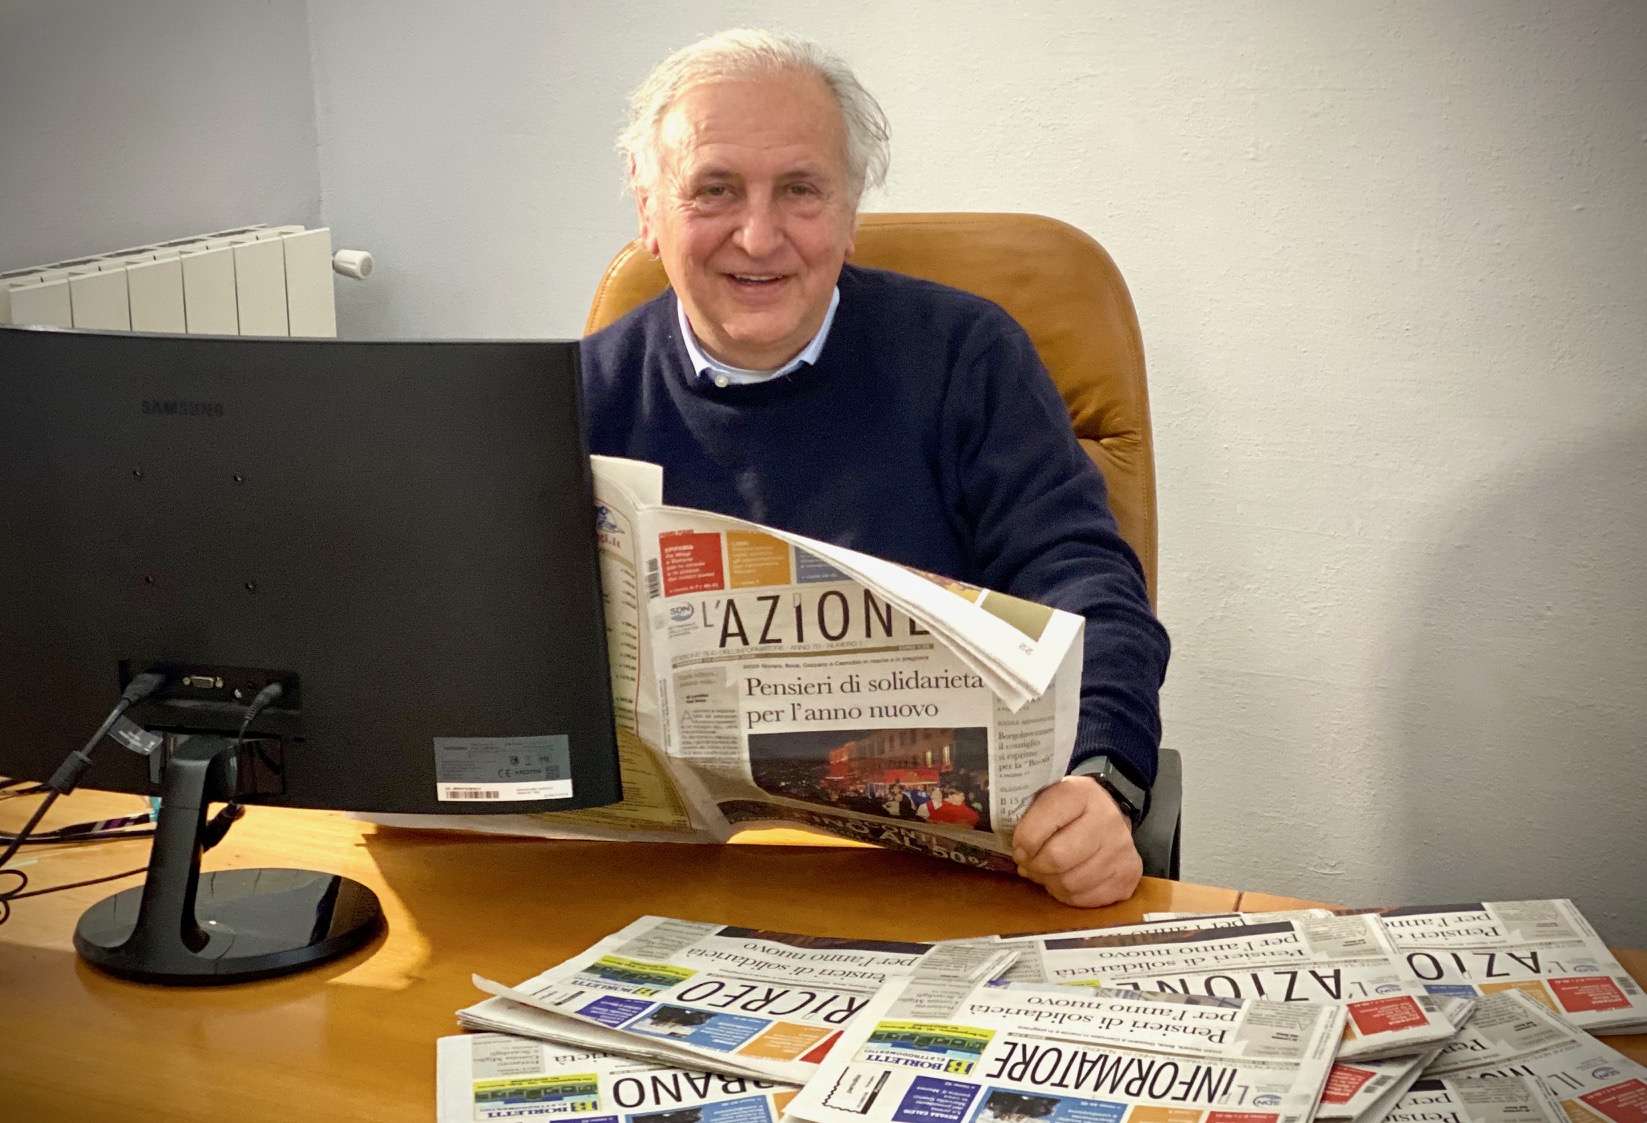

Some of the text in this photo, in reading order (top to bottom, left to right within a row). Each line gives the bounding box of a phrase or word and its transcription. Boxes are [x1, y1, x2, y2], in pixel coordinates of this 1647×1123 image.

[141, 400, 224, 417] SAMSUNG
[670, 606, 690, 615] SDN
[744, 676, 832, 697] Pensieri
[840, 674, 861, 694] di
[747, 703, 939, 729] per l'anno nuovo
[1005, 739, 1041, 752] consiglio
[999, 762, 1013, 772] per
[1453, 912, 1493, 924] per
[1410, 926, 1500, 941] Pensieri
[1098, 933, 1299, 960] per l'anno nuovo
[686, 947, 791, 976] solidarietà
[743, 942, 920, 967] per l'anno nuovo
[790, 966, 814, 976] di
[1054, 949, 1305, 978] Pensieri di solidarietà
[1406, 951, 1567, 981] L'AZIO
[571, 980, 633, 993] BORLETTI
[676, 979, 870, 1024] RICREO
[1027, 996, 1102, 1010] nuovo
[969, 1003, 1094, 1026] solidarietà
[1110, 1004, 1189, 1022] l'anno
[1197, 1009, 1238, 1023] per
[1100, 1016, 1124, 1031] di
[1130, 1019, 1227, 1044] Pensieri
[864, 1049, 946, 1062] ELETTRODOMESTICI
[865, 1054, 943, 1071] BORLETTI
[914, 1100, 952, 1109] presidente
[1409, 1093, 1452, 1105] per
[487, 1107, 568, 1118] BORLETTI
[930, 1111, 959, 1120] NOVARA
